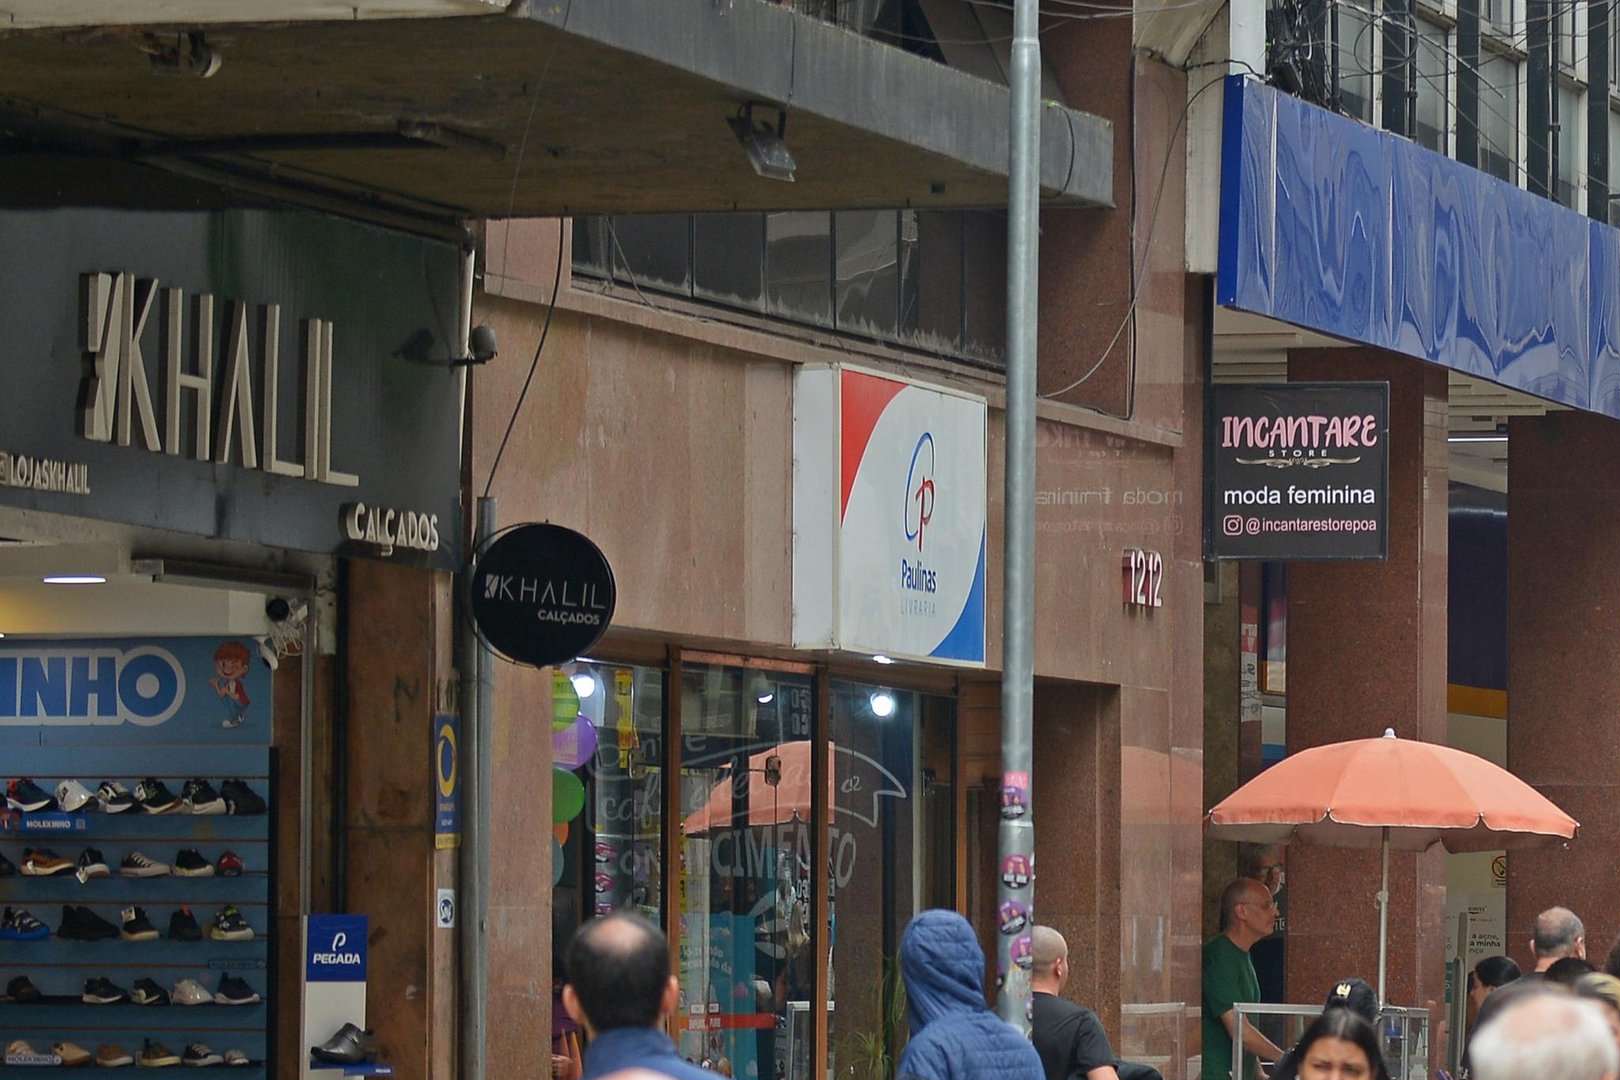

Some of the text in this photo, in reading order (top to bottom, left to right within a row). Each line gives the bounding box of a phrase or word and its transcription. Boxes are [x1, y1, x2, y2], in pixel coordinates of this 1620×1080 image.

[117, 272, 360, 488] KHALIL
[1222, 415, 1378, 449] INCANTARE
[1268, 449, 1328, 458] STORE
[1224, 485, 1375, 505] moda feminina
[346, 501, 440, 557] CALÇADOS
[499, 575, 606, 609] KHALIL
[901, 558, 937, 594] Paulinas
[1123, 549, 1164, 609] 1212
[537, 609, 600, 625] CALÇADOS
[313, 953, 361, 965] PEGADA
